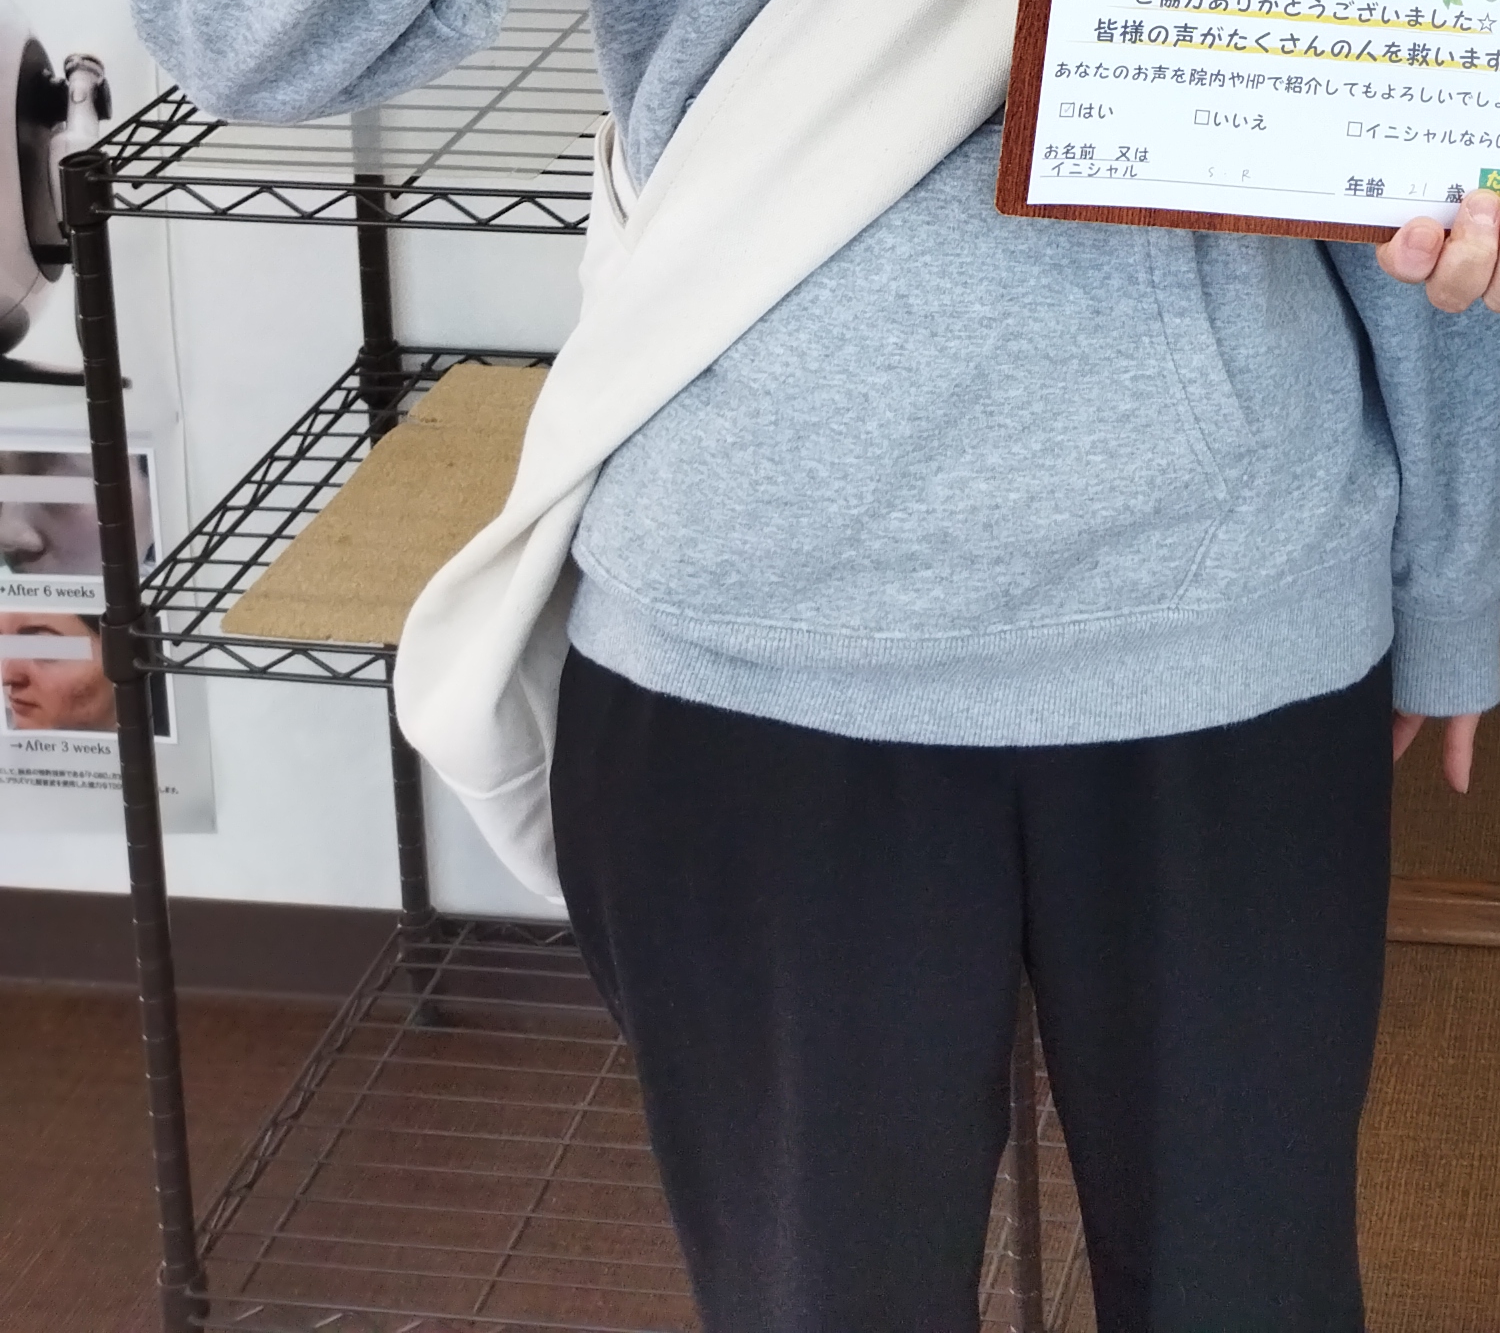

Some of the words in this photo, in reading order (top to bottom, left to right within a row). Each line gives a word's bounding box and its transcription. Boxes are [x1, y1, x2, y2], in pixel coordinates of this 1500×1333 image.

[1051, 162, 1138, 178] イニシャル
[1345, 176, 1385, 198] 年齢
[8, 584, 39, 596] After
[44, 585, 52, 597] 6
[55, 586, 96, 598] weeks
[25, 740, 56, 752] After
[61, 741, 69, 753] 3
[73, 743, 111, 755] weeks
